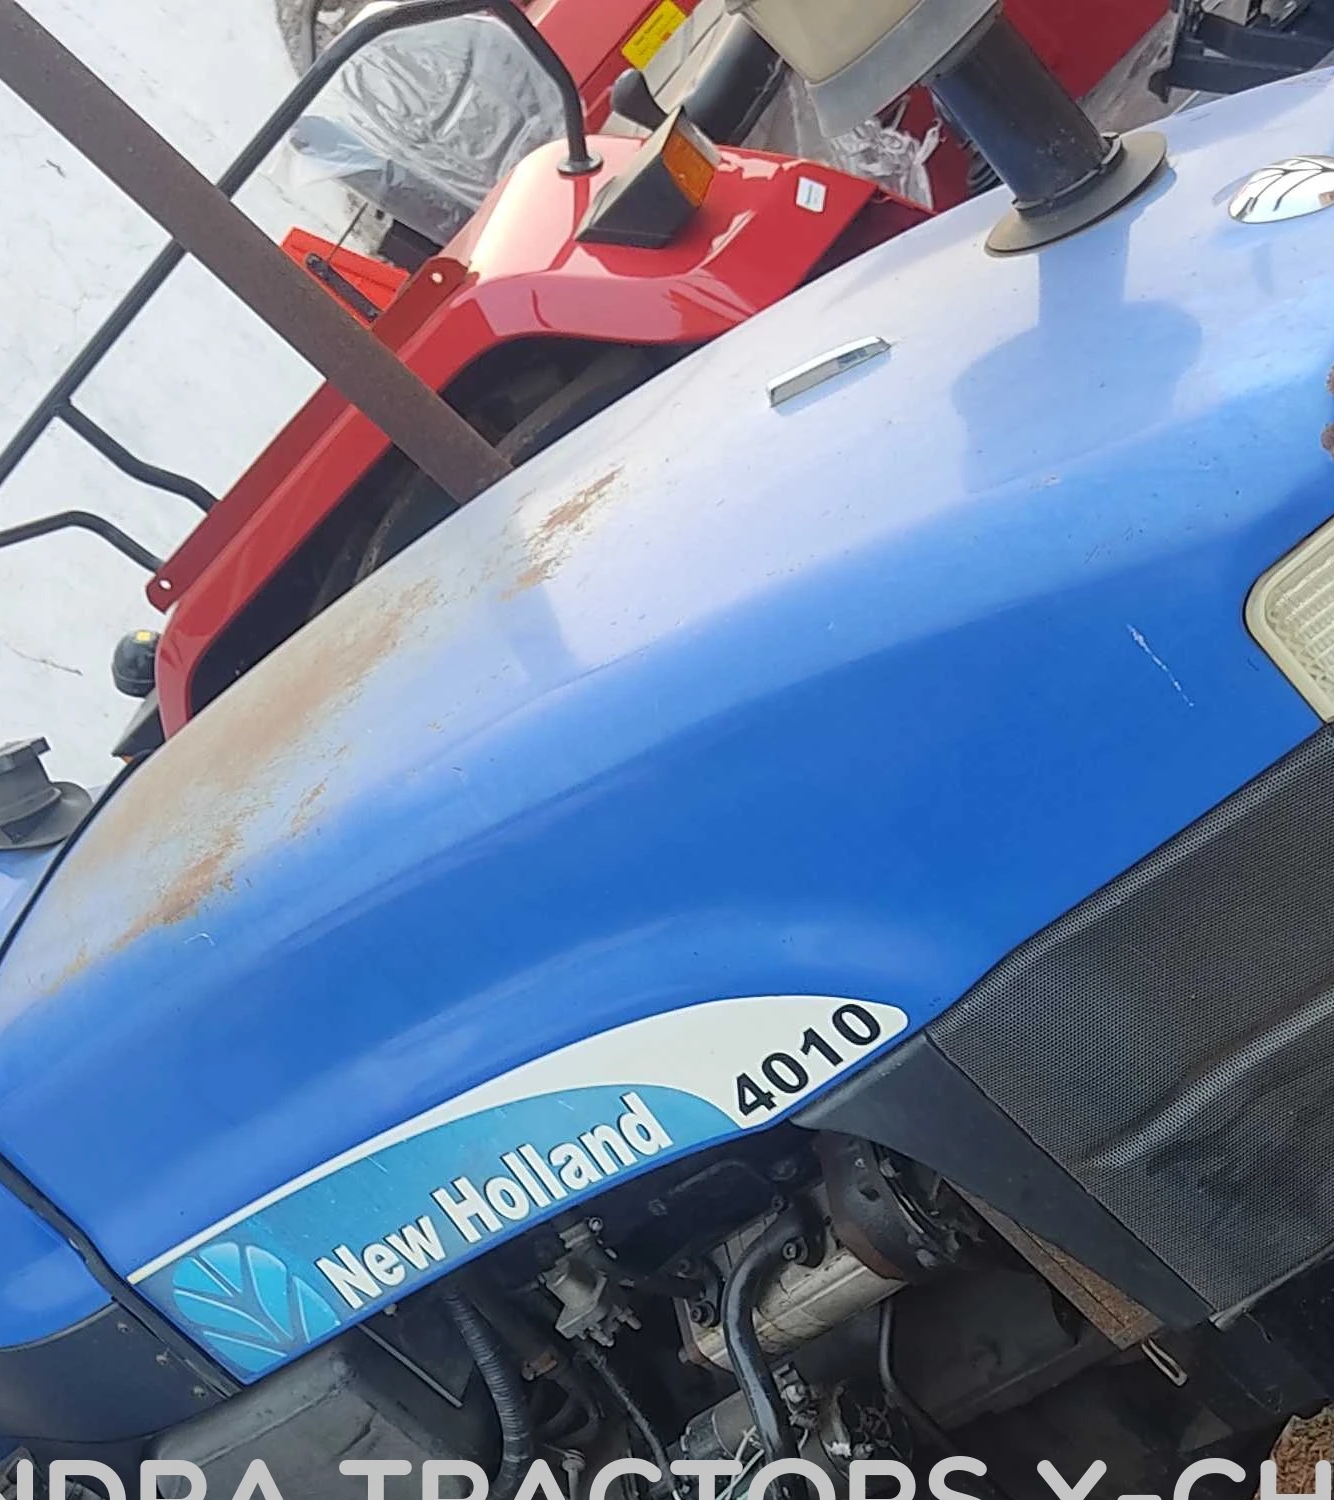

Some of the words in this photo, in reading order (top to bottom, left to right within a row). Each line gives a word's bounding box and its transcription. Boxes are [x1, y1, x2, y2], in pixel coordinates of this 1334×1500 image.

[315, 1213, 446, 1311] New
[431, 1092, 674, 1245] Holland
[730, 1003, 883, 1119] 4010
